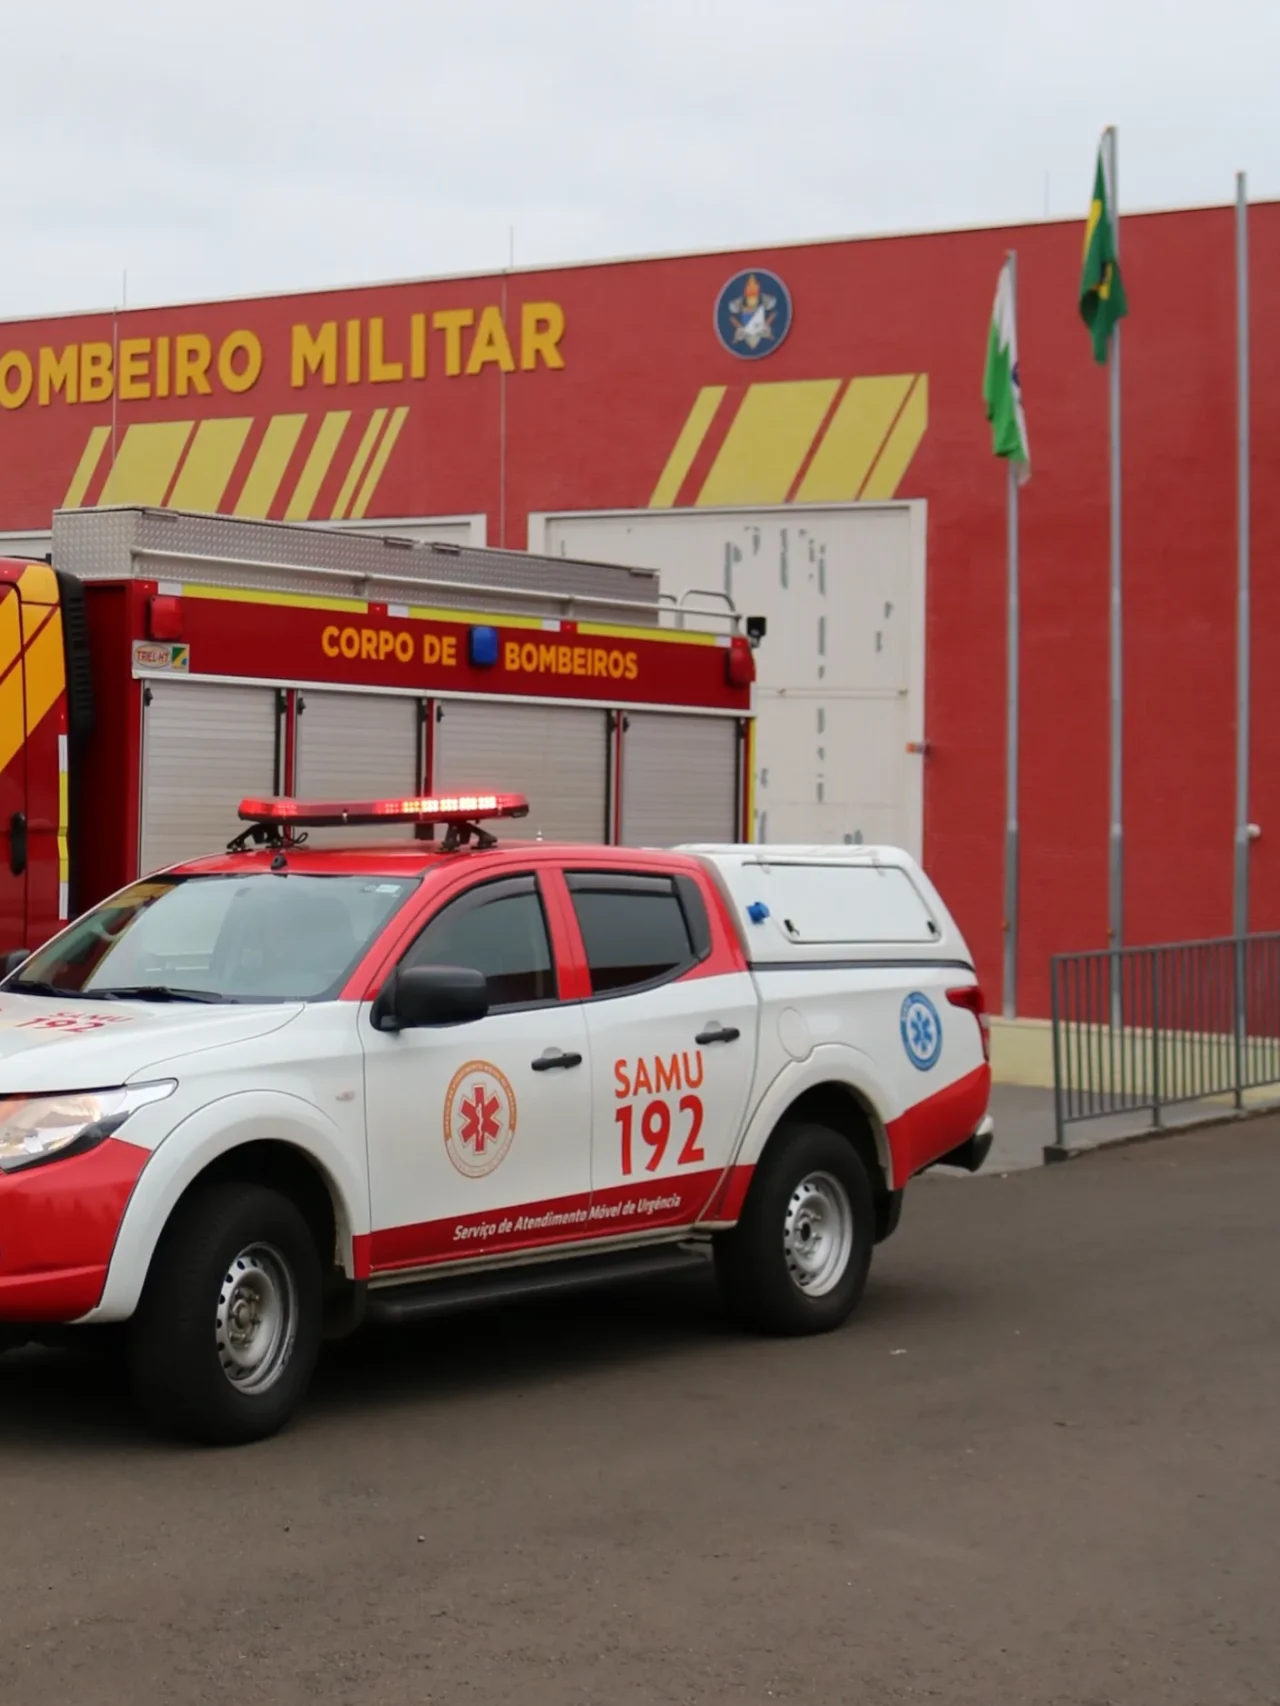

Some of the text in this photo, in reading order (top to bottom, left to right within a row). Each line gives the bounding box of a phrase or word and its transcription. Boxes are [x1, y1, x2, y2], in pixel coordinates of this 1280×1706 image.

[291, 301, 566, 388] MILITAR
[321, 625, 639, 680] CORPO DE BOMBEIROS
[614, 1050, 704, 1100] SAMU
[615, 1094, 705, 1177] 192
[453, 1193, 681, 1240] Serviço de Atendimento Móvel de Urgência
